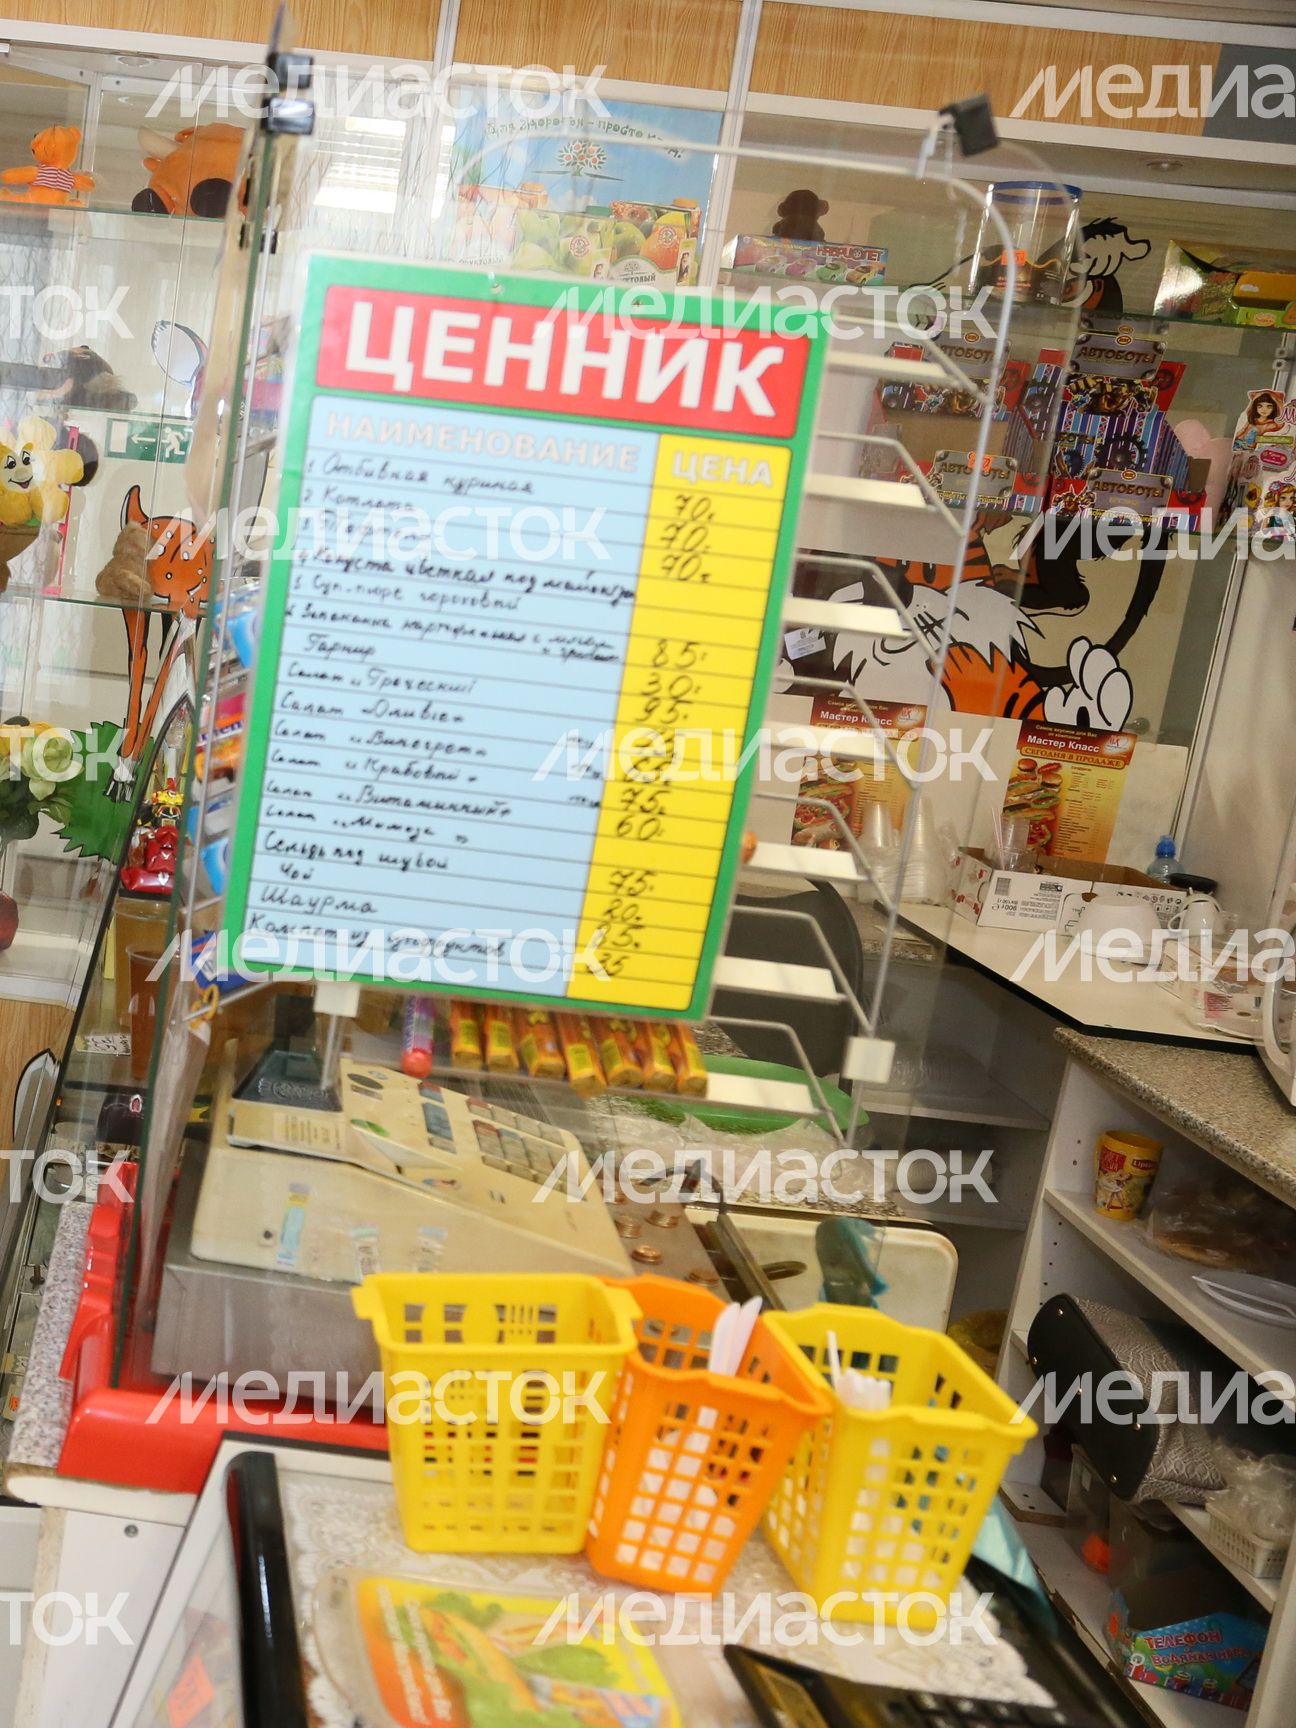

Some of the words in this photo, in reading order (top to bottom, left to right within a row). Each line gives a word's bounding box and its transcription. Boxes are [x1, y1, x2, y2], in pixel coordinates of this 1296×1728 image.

[345, 300, 785, 417] ЦЕННИК
[1075, 346, 1157, 364] АВТОБОТЫ
[325, 411, 641, 473] НАИМЕНОВАНИЕ
[671, 451, 773, 488] ЦЕНА
[1093, 480, 1165, 499] АВТОБОТЫ
[303, 632, 376, 663] Гарнир
[280, 690, 344, 716] Салат
[820, 711, 859, 723] Мастер
[1027, 734, 1066, 749] Мастер
[1068, 741, 1100, 753] Класс
[1024, 747, 1067, 760] СЕГОДНЯ
[1075, 755, 1122, 768] ПРОДАЖЕ
[260, 884, 379, 916] Шаурма
[1144, 1631, 1223, 1650] ТЕЛЕФОН
